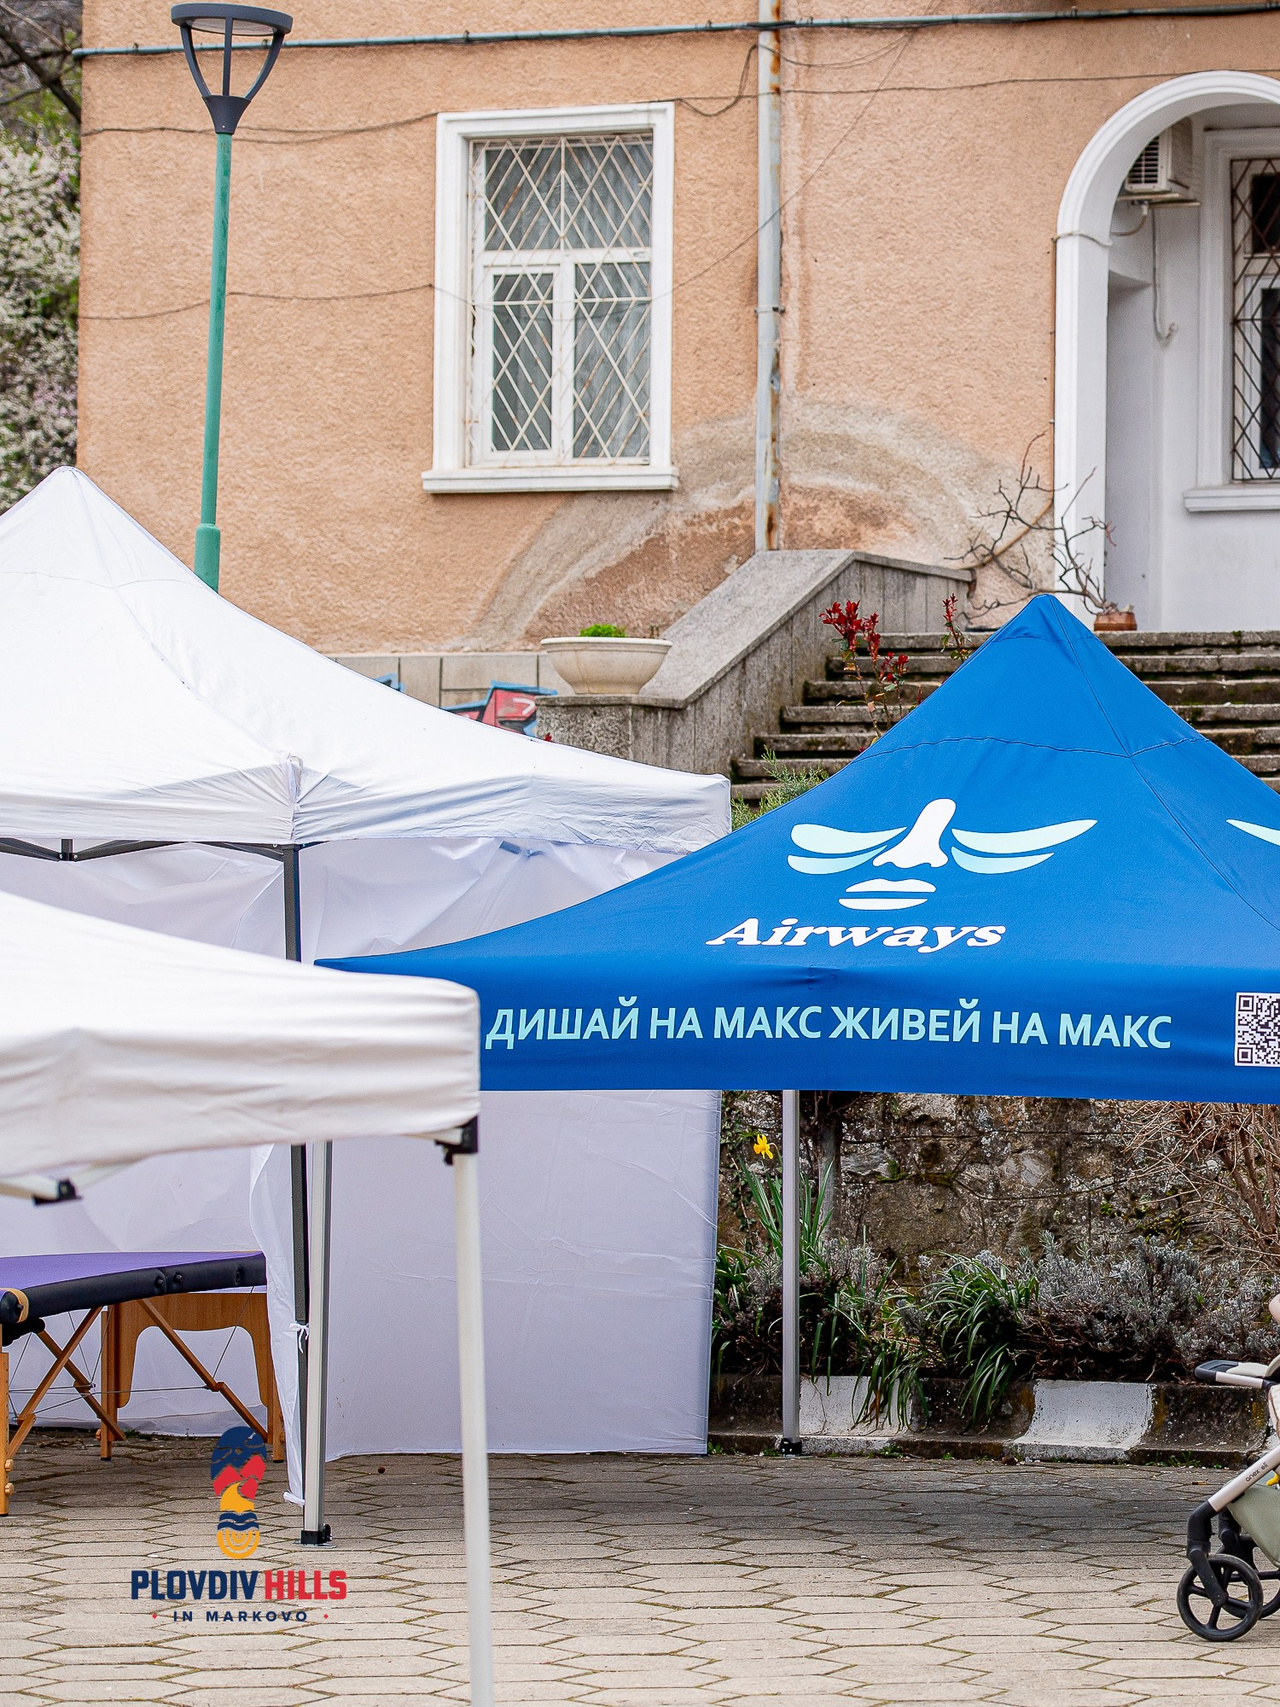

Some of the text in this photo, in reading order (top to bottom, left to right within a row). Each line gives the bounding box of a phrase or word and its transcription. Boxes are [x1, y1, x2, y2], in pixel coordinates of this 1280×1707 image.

[705, 917, 1007, 955] Airways
[485, 995, 1172, 1050] ДИШАЙ НА МАКС ЖИВЕЙ НА МАКС
